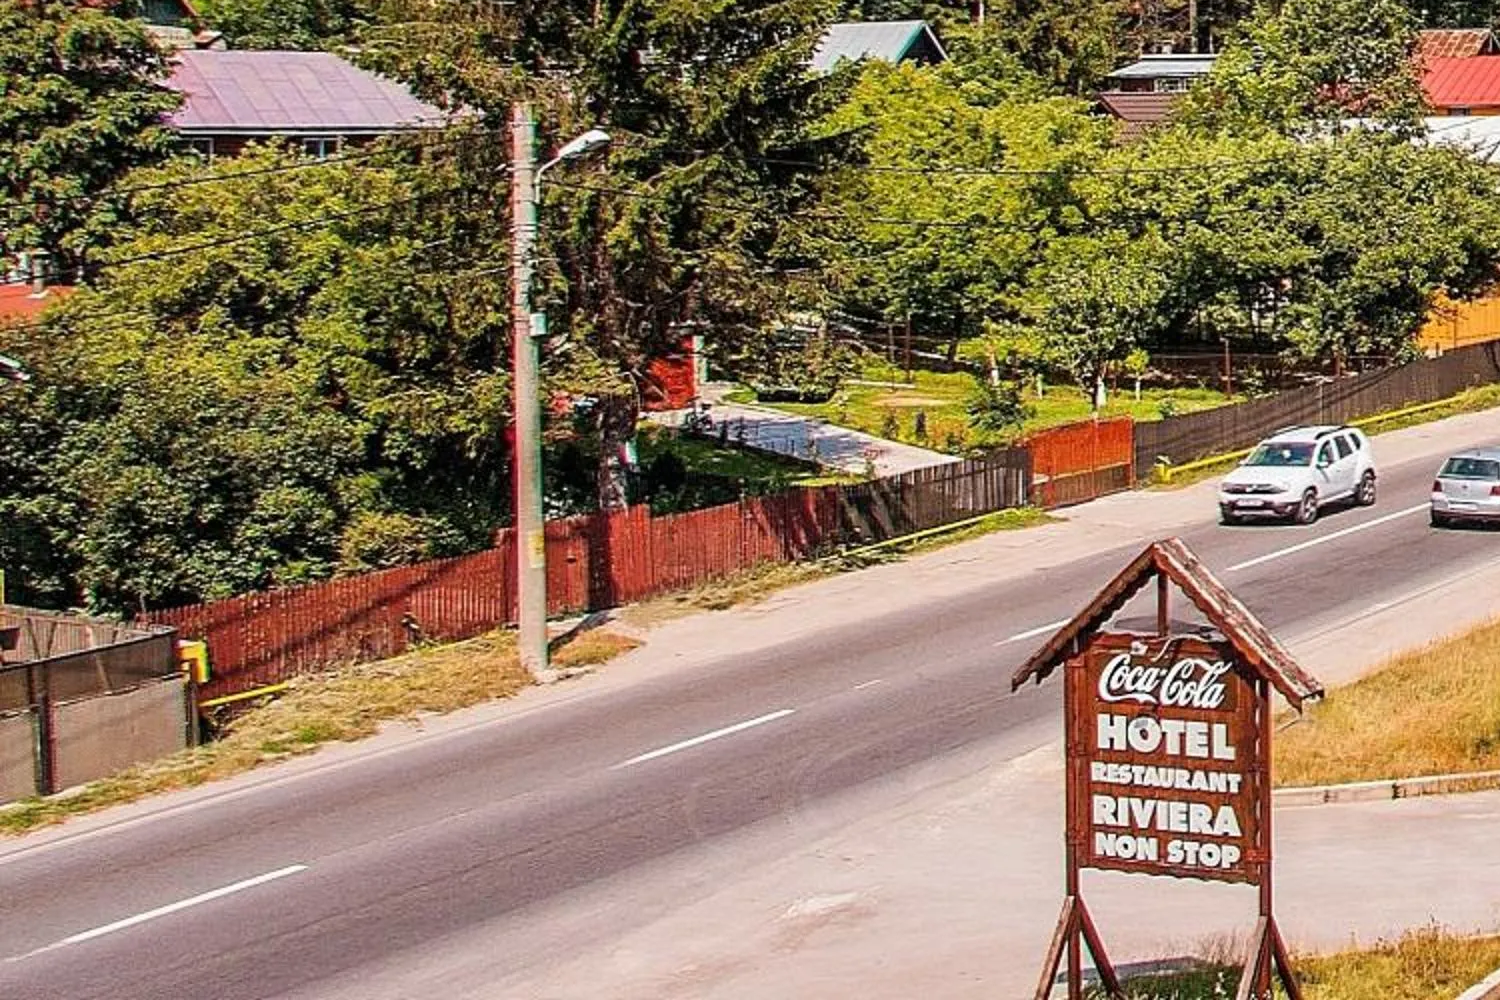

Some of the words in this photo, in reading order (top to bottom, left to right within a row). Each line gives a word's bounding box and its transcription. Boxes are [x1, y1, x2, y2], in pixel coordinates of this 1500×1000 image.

[1099, 653, 1233, 709] Coca-Cola
[1097, 713, 1236, 761] HOTEL
[1090, 761, 1242, 793] RESTAURANT
[1092, 794, 1242, 837] RIVIERA
[1095, 831, 1158, 861] NON
[1167, 839, 1241, 869] STOP
